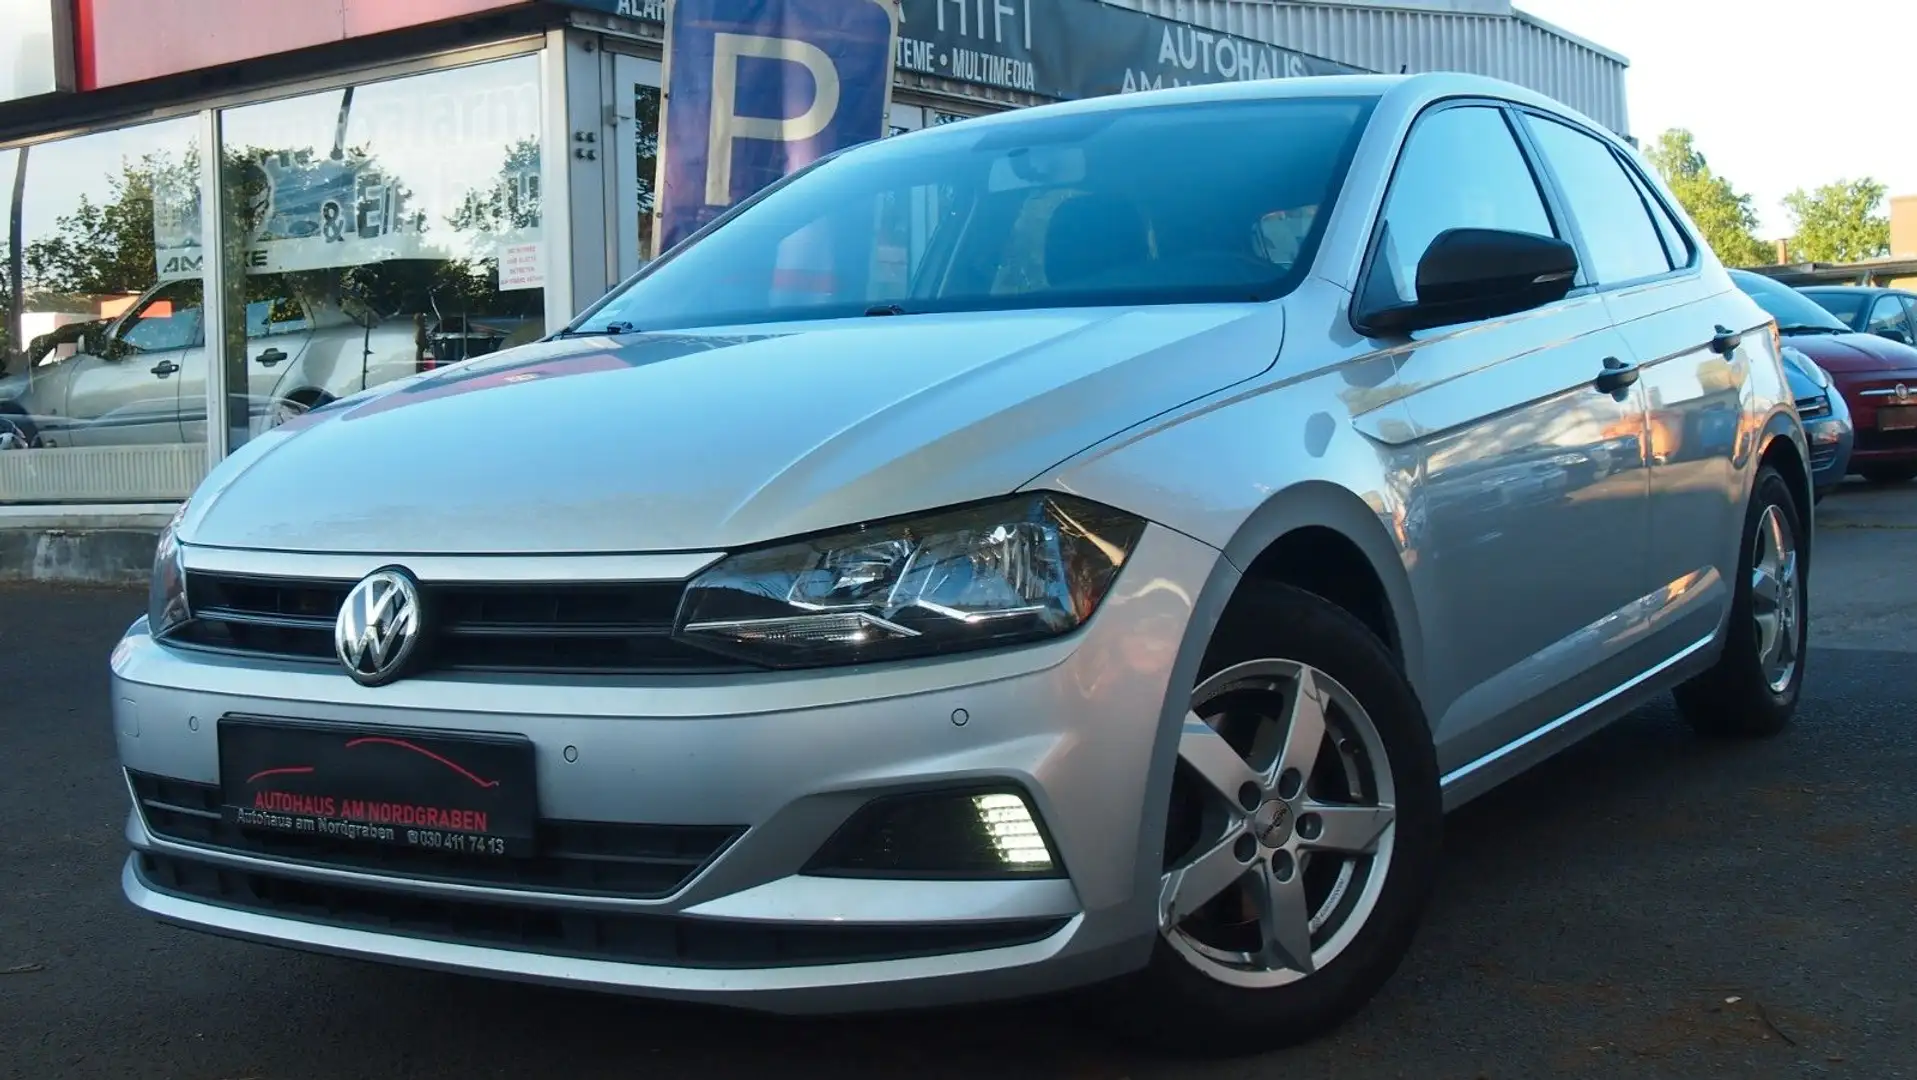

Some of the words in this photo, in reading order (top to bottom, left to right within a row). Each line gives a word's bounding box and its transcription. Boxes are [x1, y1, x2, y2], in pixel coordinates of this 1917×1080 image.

[896, 37, 935, 72] TEME
[952, 48, 1035, 91] MULTIMEDIA
[1158, 25, 1304, 81] AUTOHAUS
[705, 33, 841, 206] P
[236, 808, 292, 828] Autohaus
[295, 818, 315, 831] am
[318, 817, 395, 839] Nordgraben
[420, 830, 442, 848] 030
[444, 833, 465, 850] 411
[469, 835, 486, 852] 74
[488, 837, 505, 855] 13
[254, 791, 335, 816] AUTOHAUS
[341, 800, 364, 818] AM
[368, 803, 487, 832] NORDGRABEN
